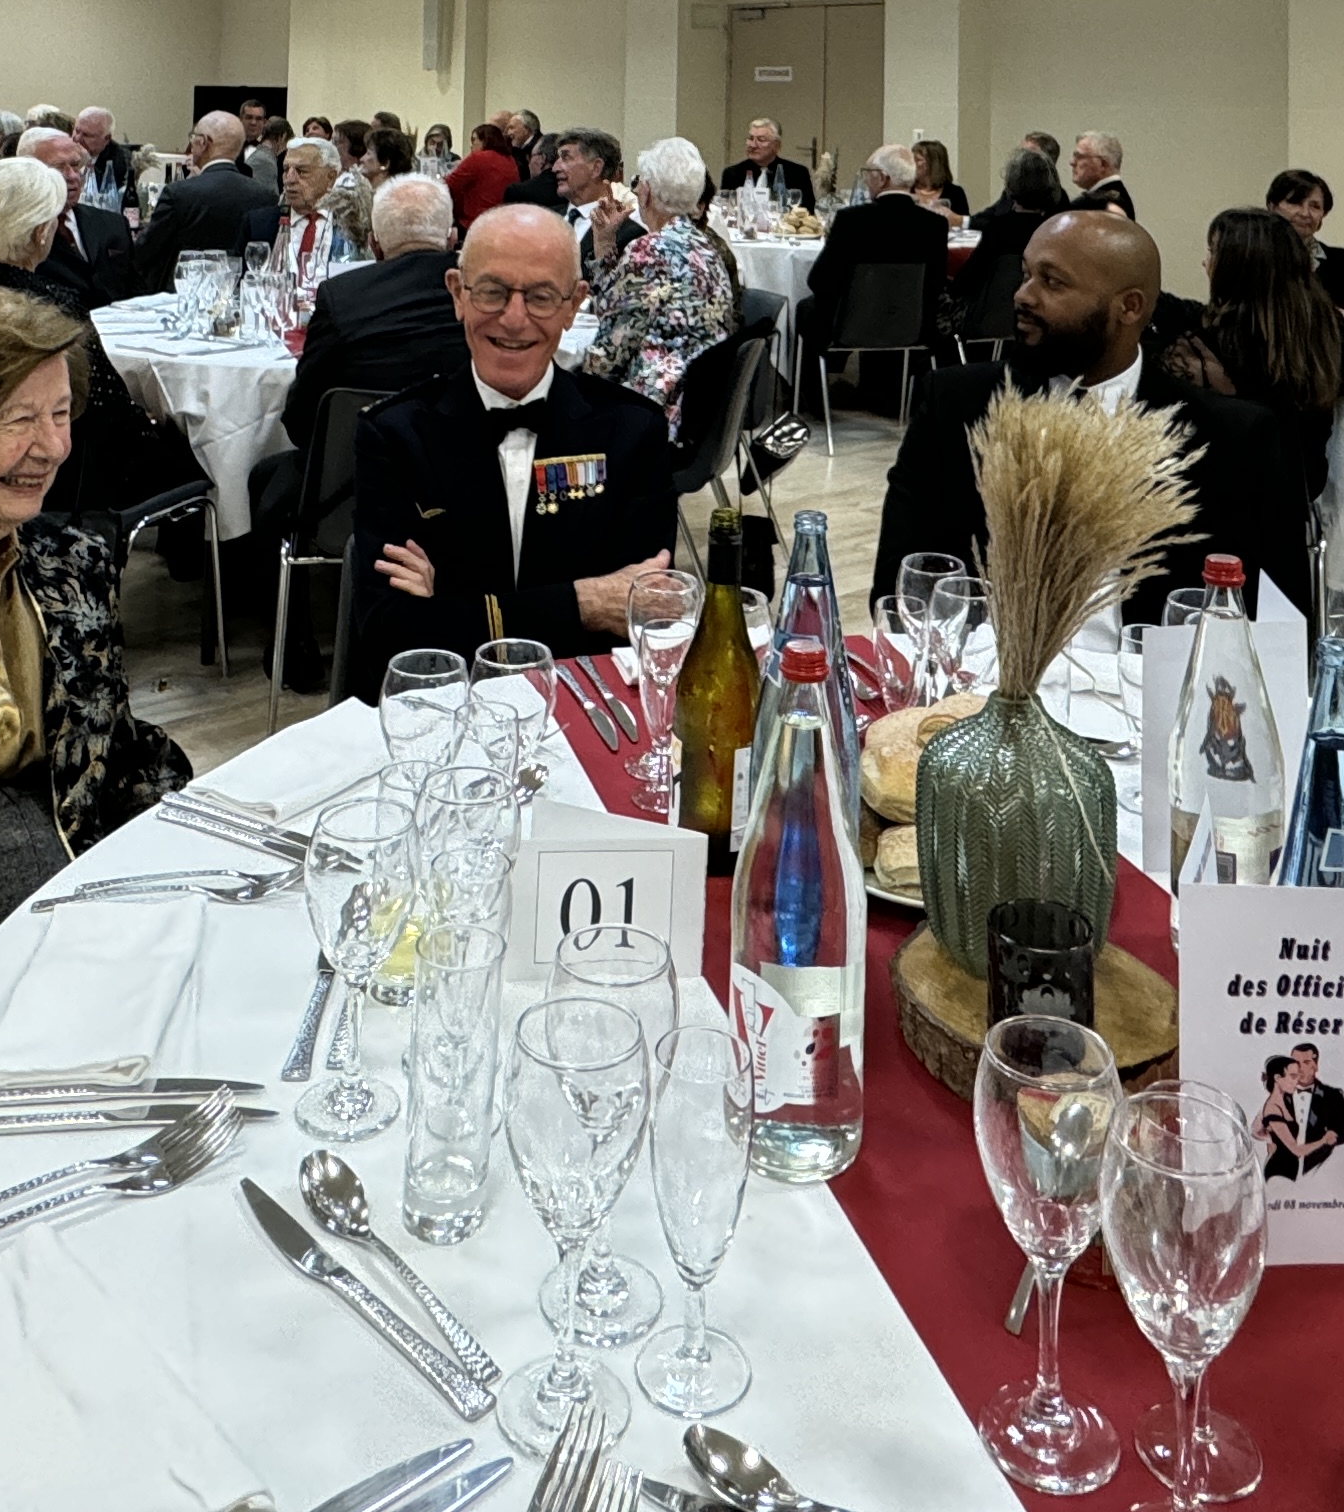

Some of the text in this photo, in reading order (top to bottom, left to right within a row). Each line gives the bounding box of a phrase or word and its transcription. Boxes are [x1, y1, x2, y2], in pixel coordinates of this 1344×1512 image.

[559, 876, 636, 952] 01
[1278, 937, 1332, 962] Nuit
[1226, 973, 1268, 998] des
[1239, 1010, 1268, 1035] de
[1283, 1199, 1296, 1209] 08
